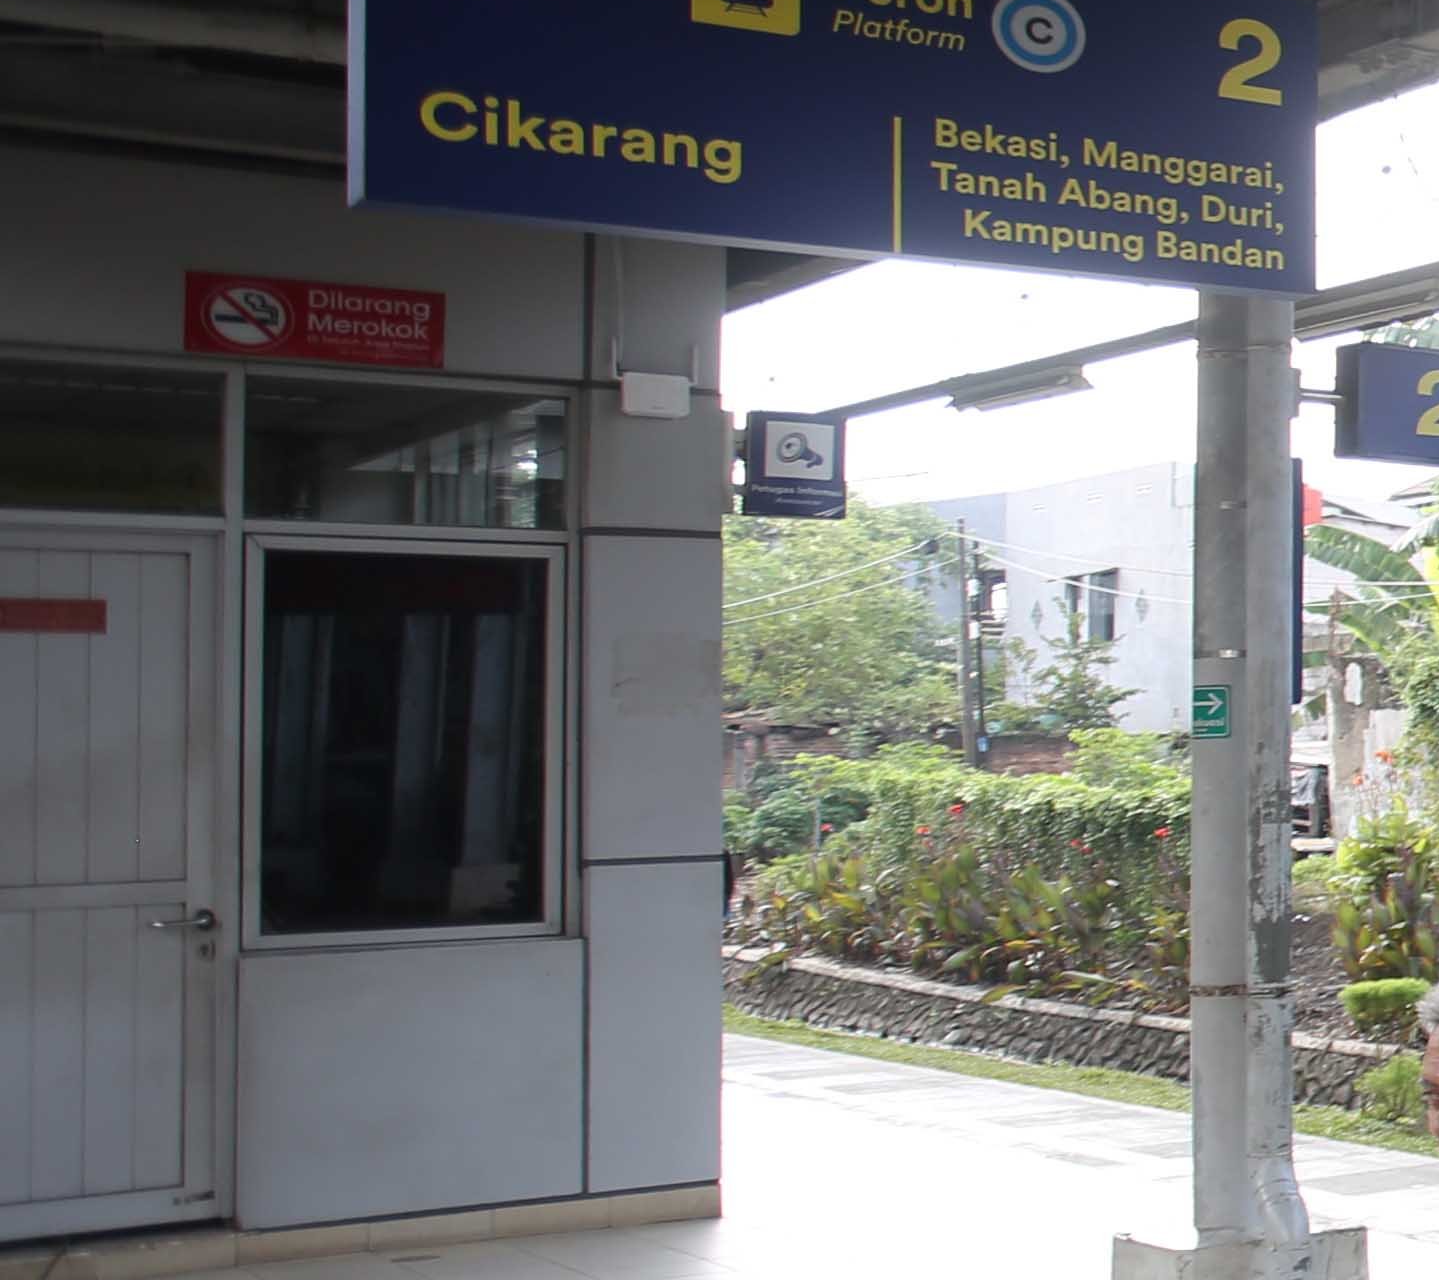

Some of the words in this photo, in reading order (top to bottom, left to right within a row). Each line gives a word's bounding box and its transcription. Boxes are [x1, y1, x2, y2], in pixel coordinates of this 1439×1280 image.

[833, 10, 967, 51] Platform
[1025, 16, 1054, 45] C
[1218, 18, 1282, 105] 2
[419, 91, 742, 183] Cikarang
[935, 118, 1069, 163] Bekasi,
[1083, 138, 1284, 193] Manggarai,
[933, 160, 1046, 201] Tanah
[1060, 178, 1191, 225] Abang,
[1202, 195, 1284, 233] Duri,
[964, 210, 1143, 260] Kampung
[1157, 231, 1284, 269] Bandan
[307, 314, 428, 339] Merokok
[308, 290, 431, 321] Dilarang
